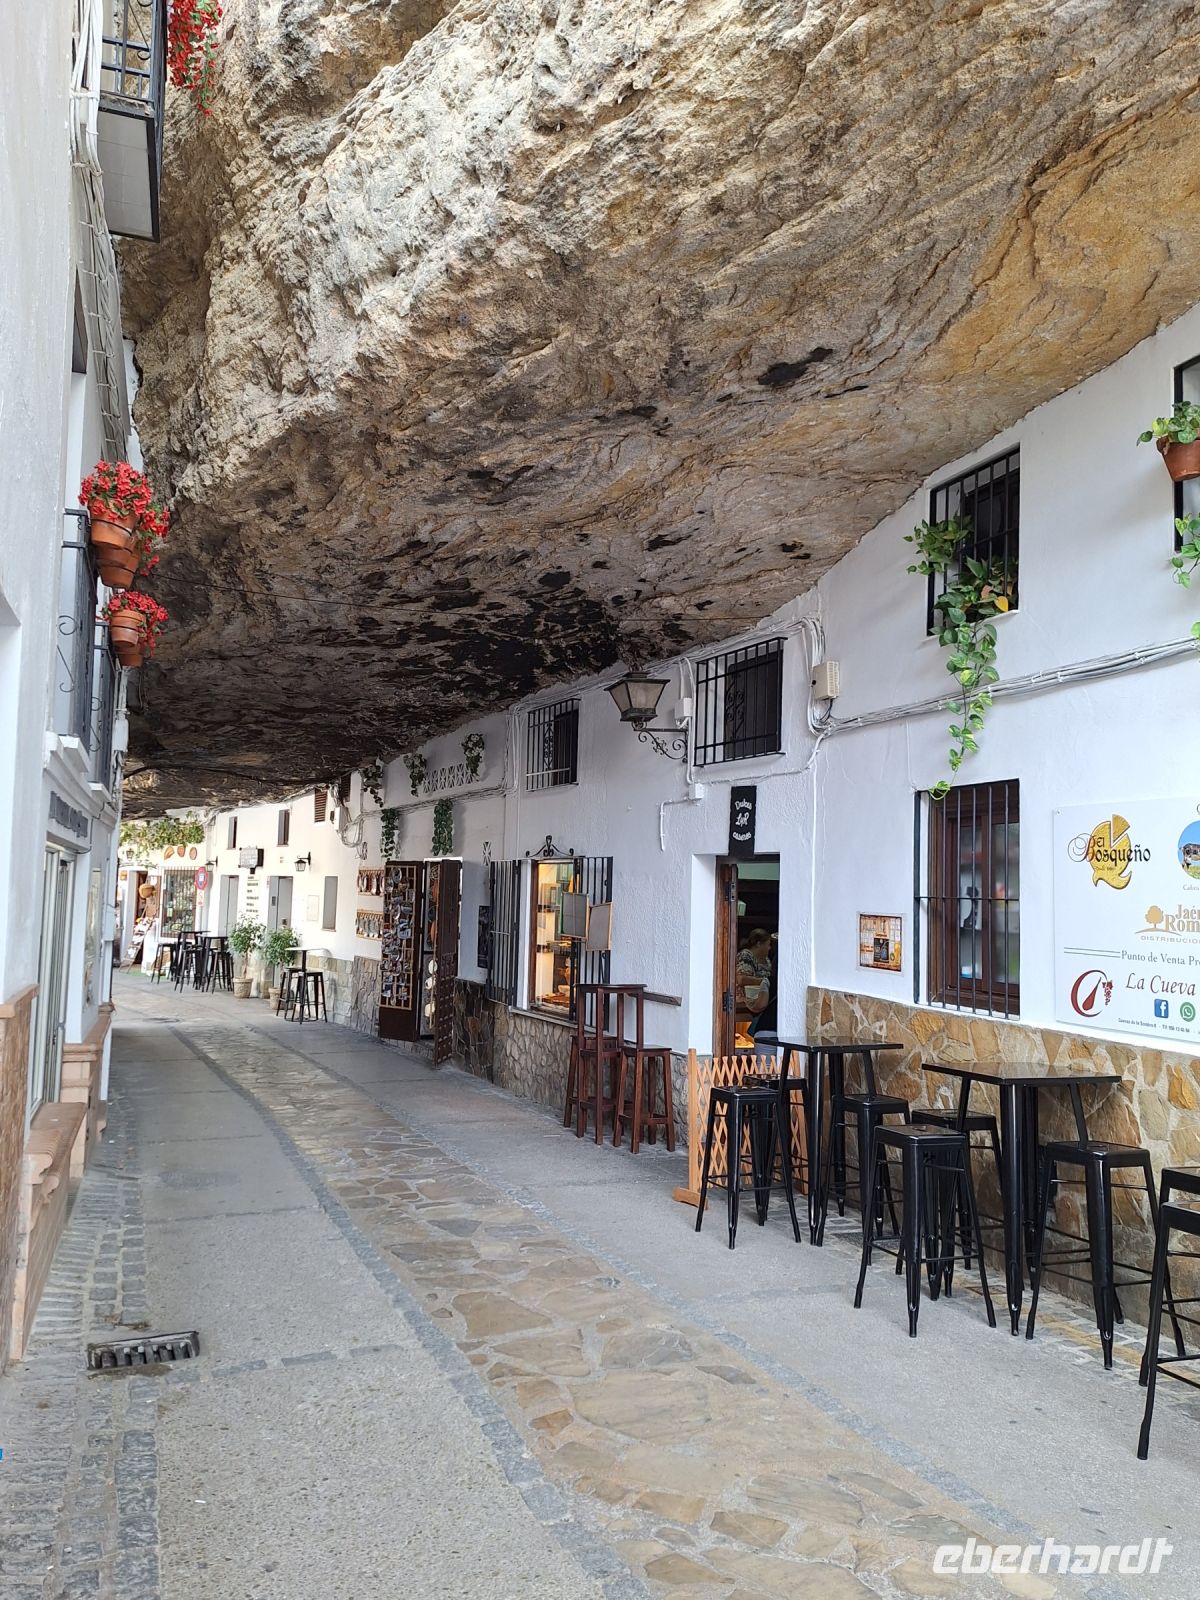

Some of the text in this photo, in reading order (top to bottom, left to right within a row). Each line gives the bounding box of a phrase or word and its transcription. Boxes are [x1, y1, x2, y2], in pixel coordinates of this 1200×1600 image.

[1067, 833, 1151, 867] Bosqueño
[1096, 836, 1105, 848] El
[1121, 950, 1146, 962] Punto
[1147, 951, 1158, 963] de
[1160, 952, 1186, 965] Venta
[1126, 973, 1195, 996] La Cueva
